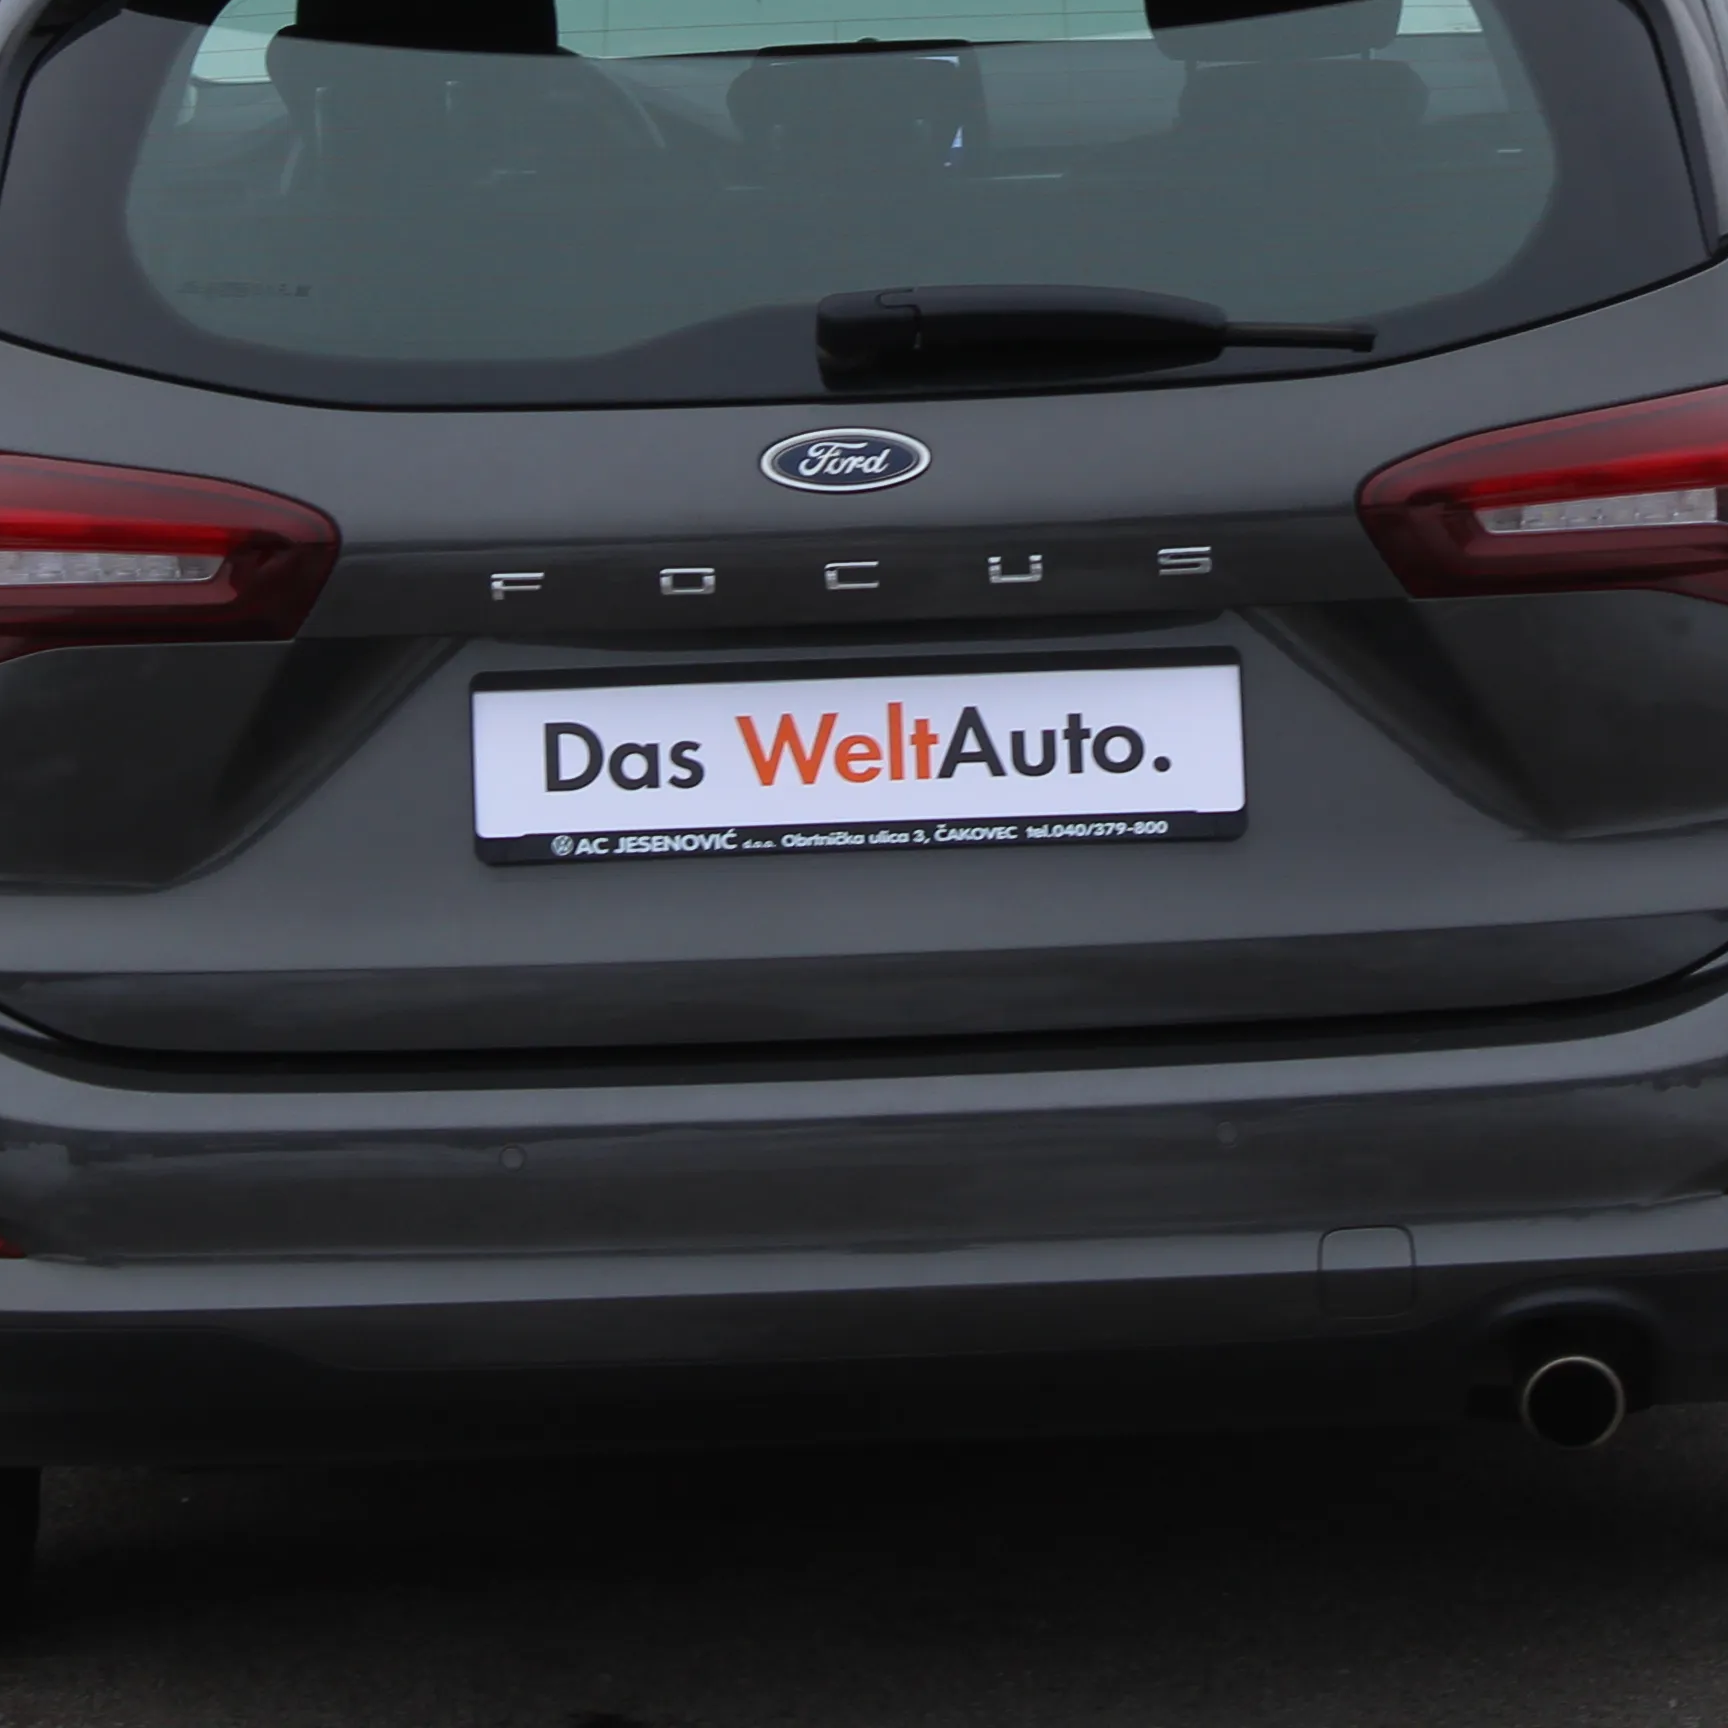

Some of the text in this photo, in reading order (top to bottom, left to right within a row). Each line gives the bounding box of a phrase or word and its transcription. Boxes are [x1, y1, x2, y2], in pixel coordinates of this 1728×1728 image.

[798, 441, 890, 477] Ford
[491, 546, 1212, 600] FOCUS
[545, 703, 1171, 792] Das WeltAuto.
[574, 837, 609, 855] AC
[613, 829, 737, 854] JESENOVIĆ
[869, 829, 909, 844] ulica
[934, 824, 1018, 842] ČAKOVEC
